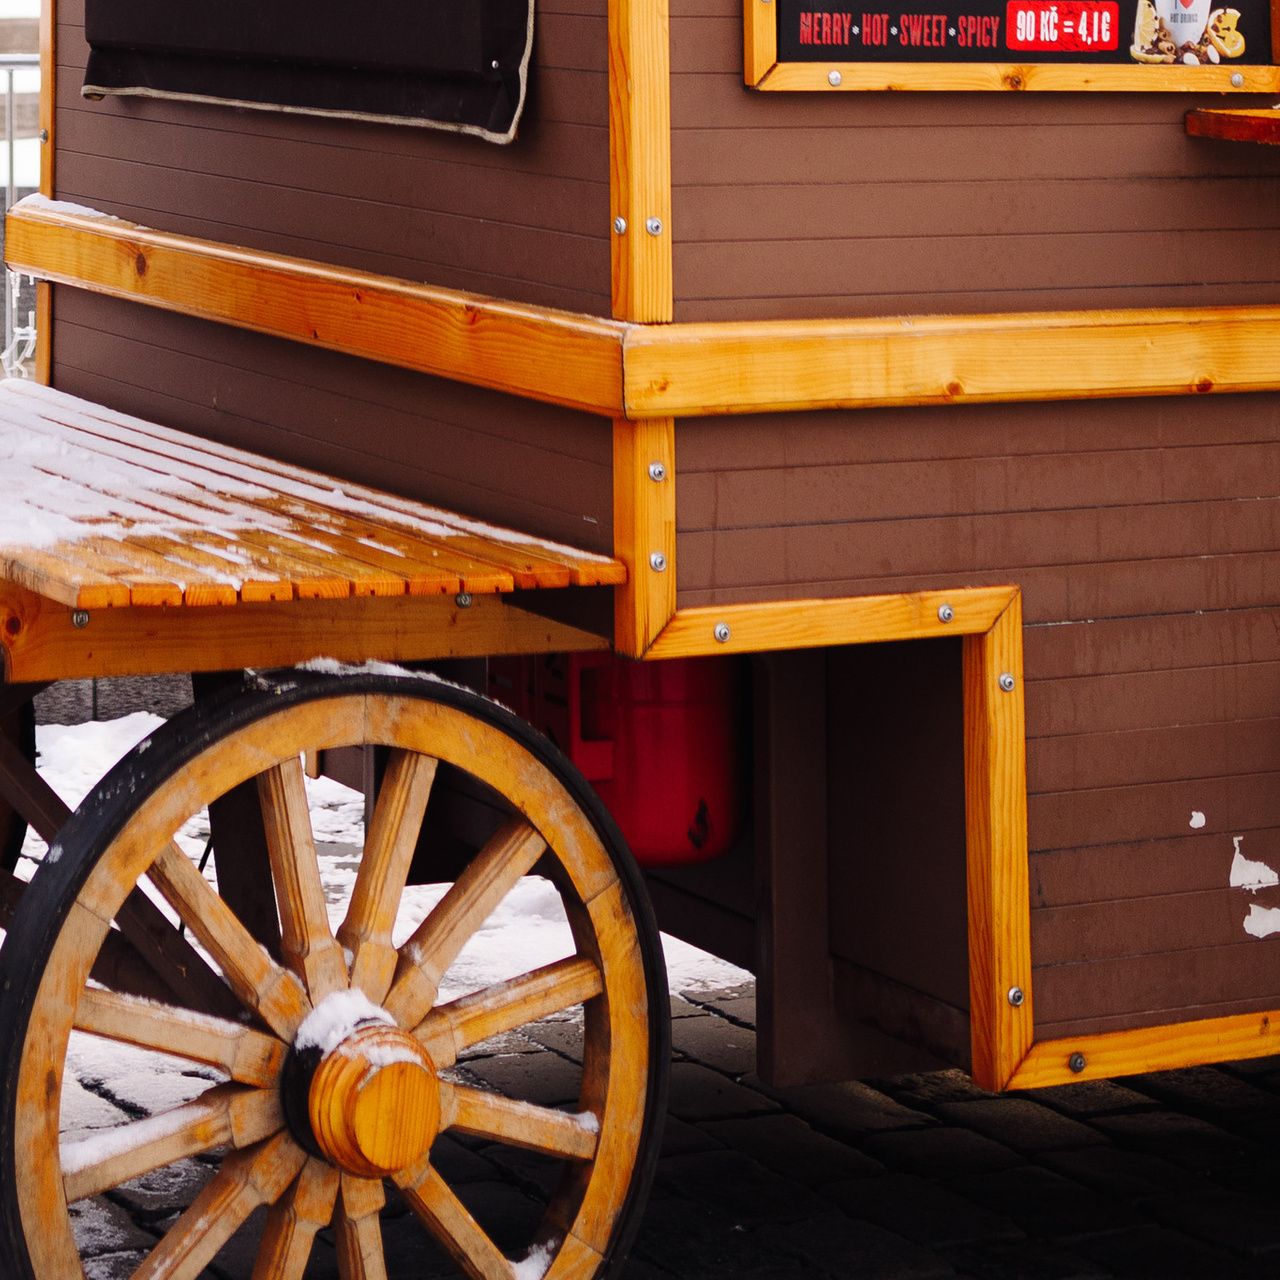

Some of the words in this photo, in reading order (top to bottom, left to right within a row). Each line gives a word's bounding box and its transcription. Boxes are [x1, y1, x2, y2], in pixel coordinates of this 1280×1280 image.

[800, 12, 851, 45] MERRY
[862, 14, 889, 45] HOT
[900, 14, 947, 46] SWEET
[958, 16, 1000, 47] SPICY
[1017, 11, 1035, 41] 90
[1040, 6, 1058, 41] KČ
[1064, 21, 1073, 32] =
[1078, 11, 1110, 45] 4,1€
